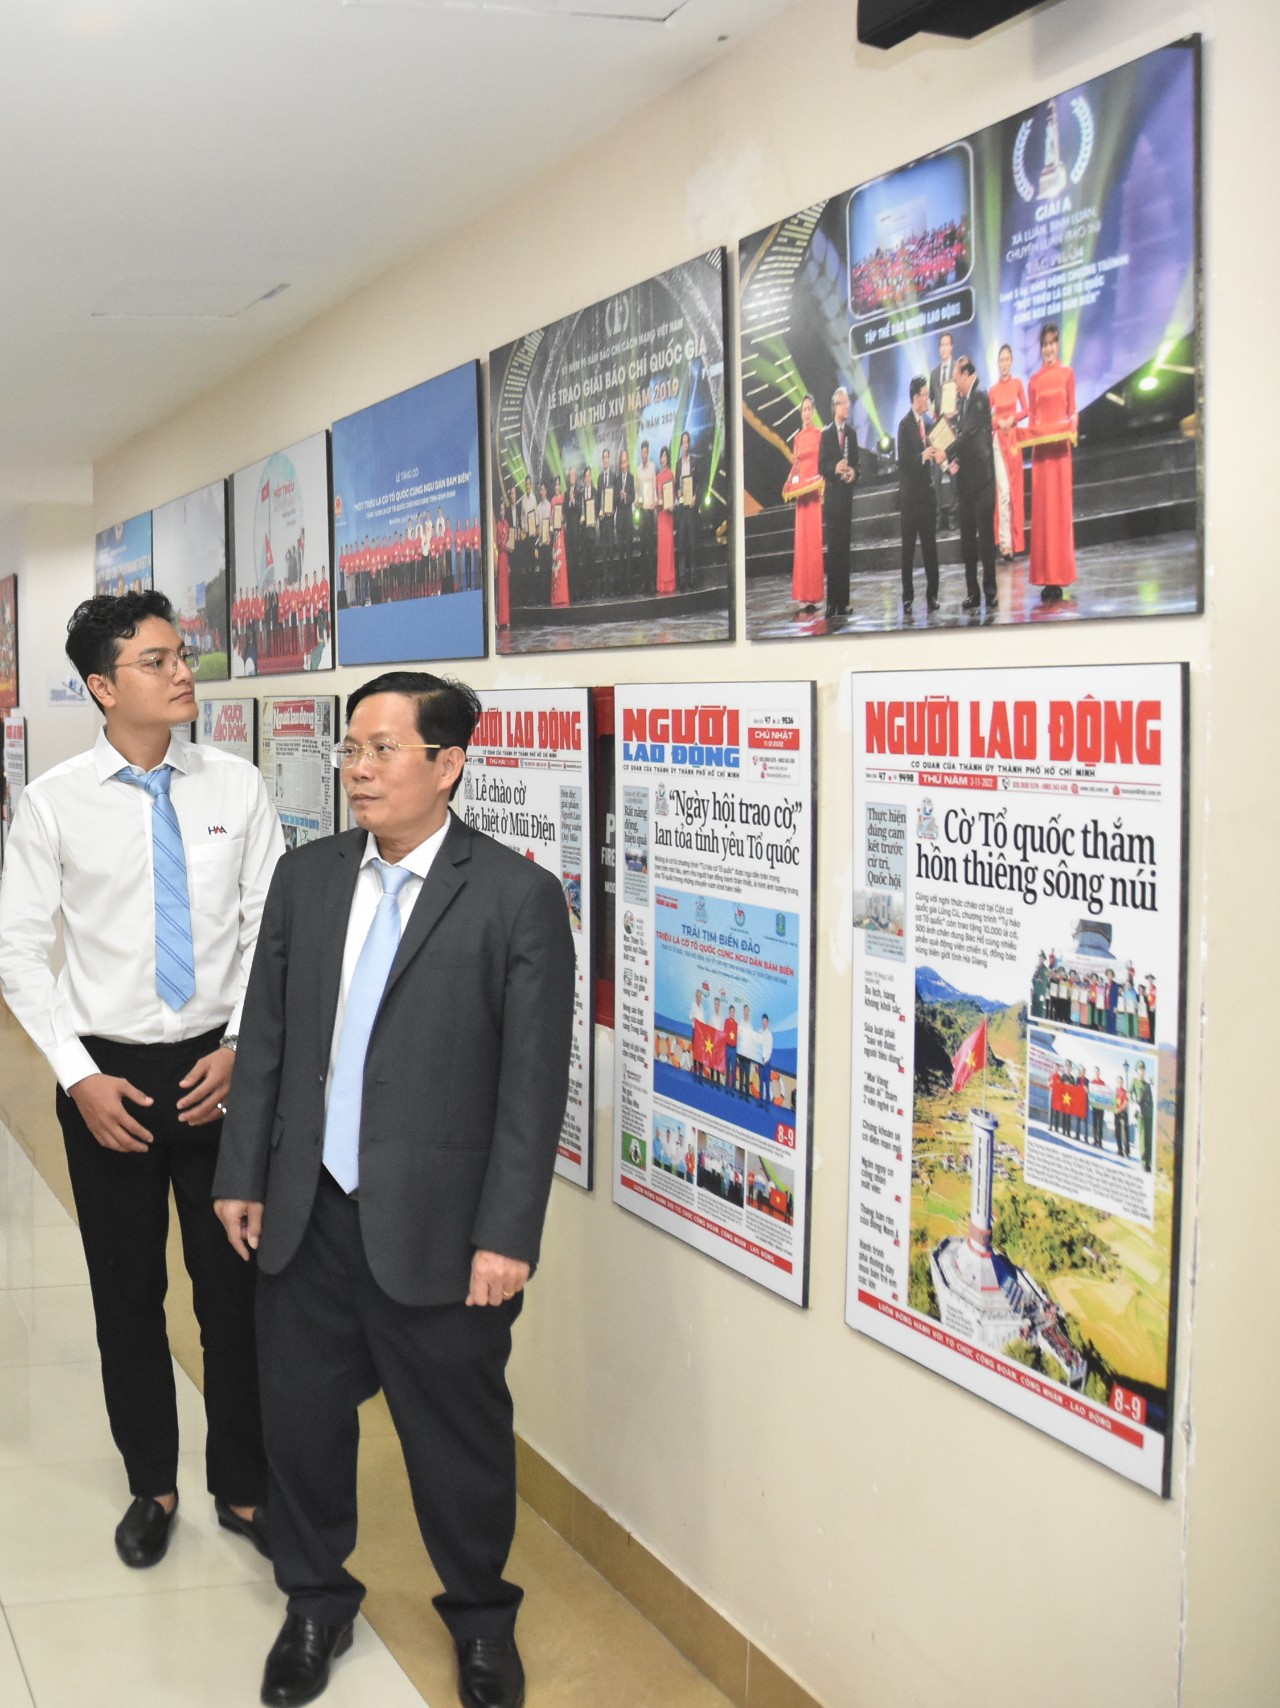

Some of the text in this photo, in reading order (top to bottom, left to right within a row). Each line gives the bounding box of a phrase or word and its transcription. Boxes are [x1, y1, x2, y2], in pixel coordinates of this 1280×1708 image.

[548, 336, 706, 410] LỄ TRAO GIẢI BÁO CHÍ QUỐC GIA
[569, 378, 679, 430] LẦN THỨ XIV NĂM 2019
[469, 708, 581, 752] GƯỜI LAO ĐỘNG
[623, 706, 739, 746] NGƯỜI
[755, 730, 793, 741] CHỦ NHẬT
[866, 694, 1161, 767] NGƯỜI LAO ĐỘNG
[623, 744, 664, 763] LAO
[671, 743, 739, 768] ĐỘNG
[943, 761, 956, 770] CỦA
[959, 762, 982, 771] THÀNH
[985, 763, 994, 772] ỦY
[998, 763, 1022, 773] THÀNH
[1025, 764, 1040, 774] PHỐ
[1044, 765, 1055, 775] HỒ
[1059, 766, 1072, 776] CHÍ
[1075, 768, 1095, 777] MINH
[476, 774, 526, 806] Lễ chào cờ
[879, 772, 886, 780] 47
[898, 774, 914, 782] 9498
[922, 773, 941, 784] THỨ
[944, 775, 968, 785] NĂM
[669, 789, 710, 827] “Ngày
[712, 792, 735, 828] hội
[739, 798, 769, 826] trao
[868, 808, 906, 826] Thực hiện
[482, 807, 499, 838] biệt
[501, 809, 508, 835] ở
[510, 812, 529, 838] Mũi
[531, 814, 556, 846] Điện
[868, 823, 904, 840] đúng cam
[944, 807, 1156, 865] Cờ Tổ quốc thắm
[655, 822, 800, 869] lan tỏa tình yêu Tổ quốc
[868, 838, 903, 855] kết trước
[868, 854, 876, 868] cử
[868, 871, 901, 890] Quốc hội
[916, 843, 1158, 915] hồn thiêng sông núi
[682, 924, 700, 939] TRÁI
[702, 930, 716, 942] TIM
[741, 938, 760, 954] ĐẢO
[984, 926, 1002, 936] 10.000
[778, 1124, 794, 1147] 8-9
[1070, 1401, 1085, 1414] LAO
[1114, 1388, 1141, 1420] 8-9
